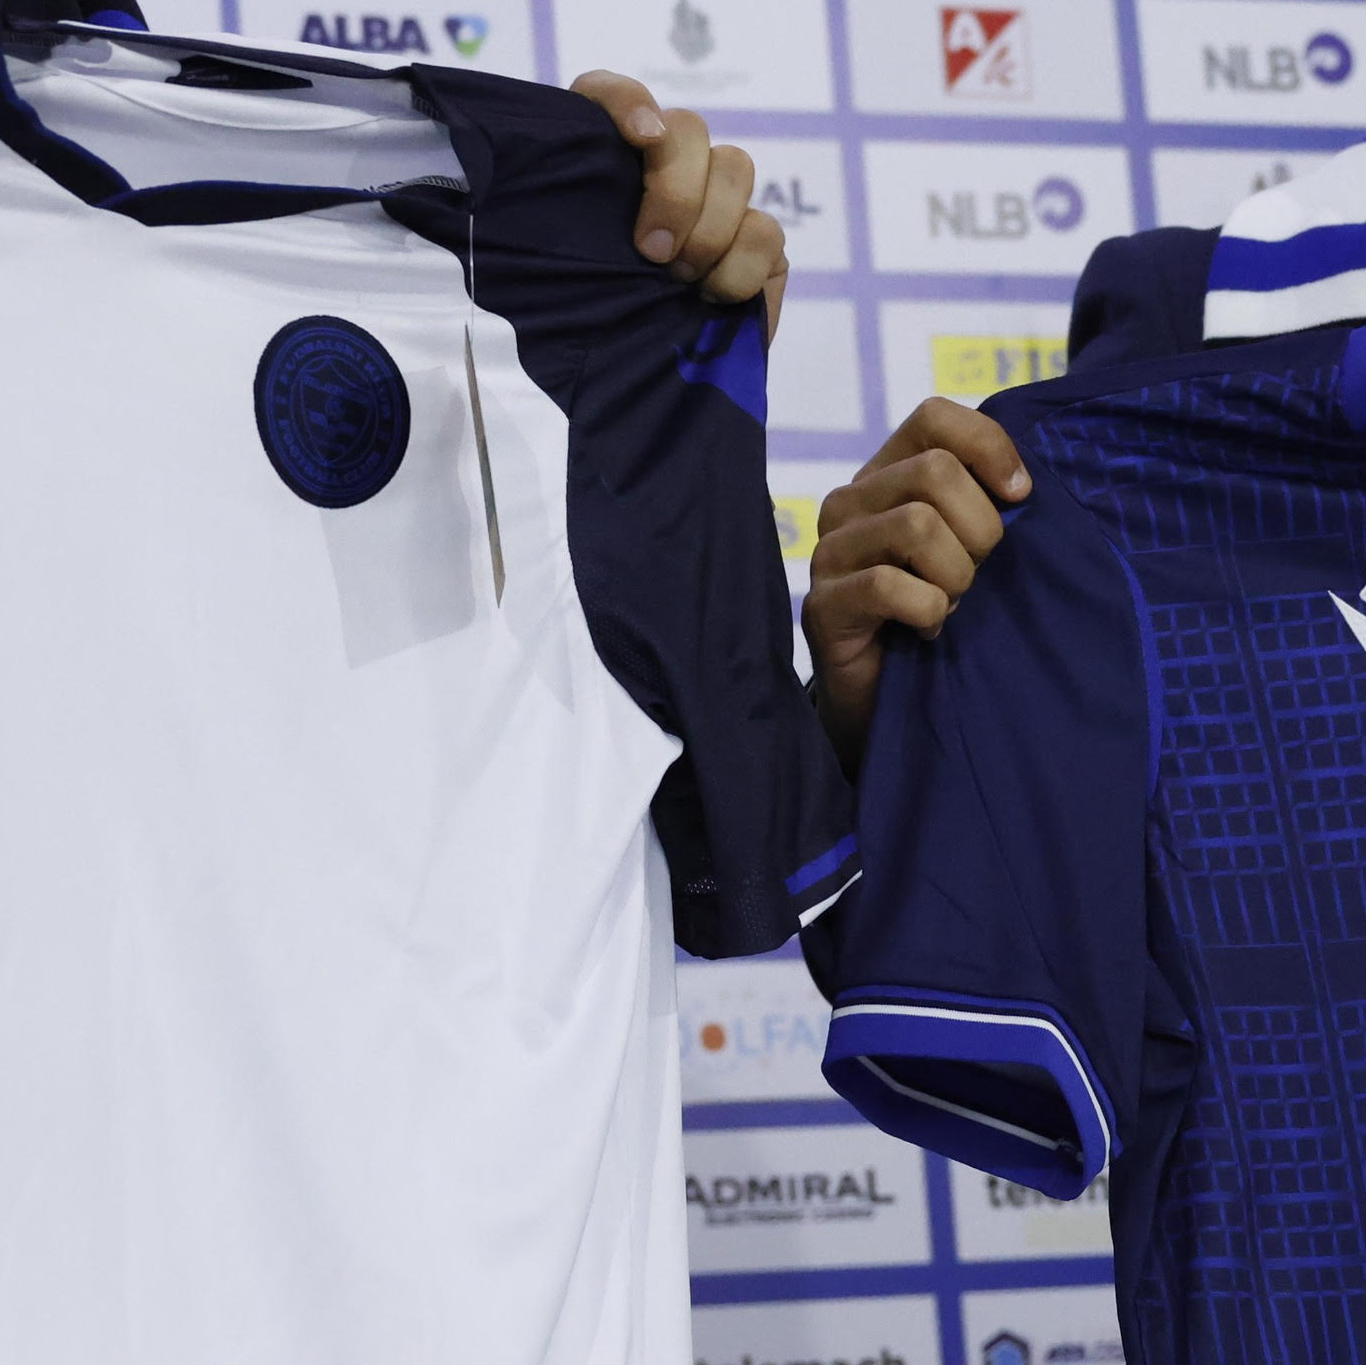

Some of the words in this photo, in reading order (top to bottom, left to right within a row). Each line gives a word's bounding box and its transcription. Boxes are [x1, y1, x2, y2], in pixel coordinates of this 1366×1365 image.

[299, 14, 429, 54] ALBA
[1205, 45, 1302, 93] NLB
[927, 190, 1033, 238] NLB
[686, 1168, 895, 1208] ADMIRAL
